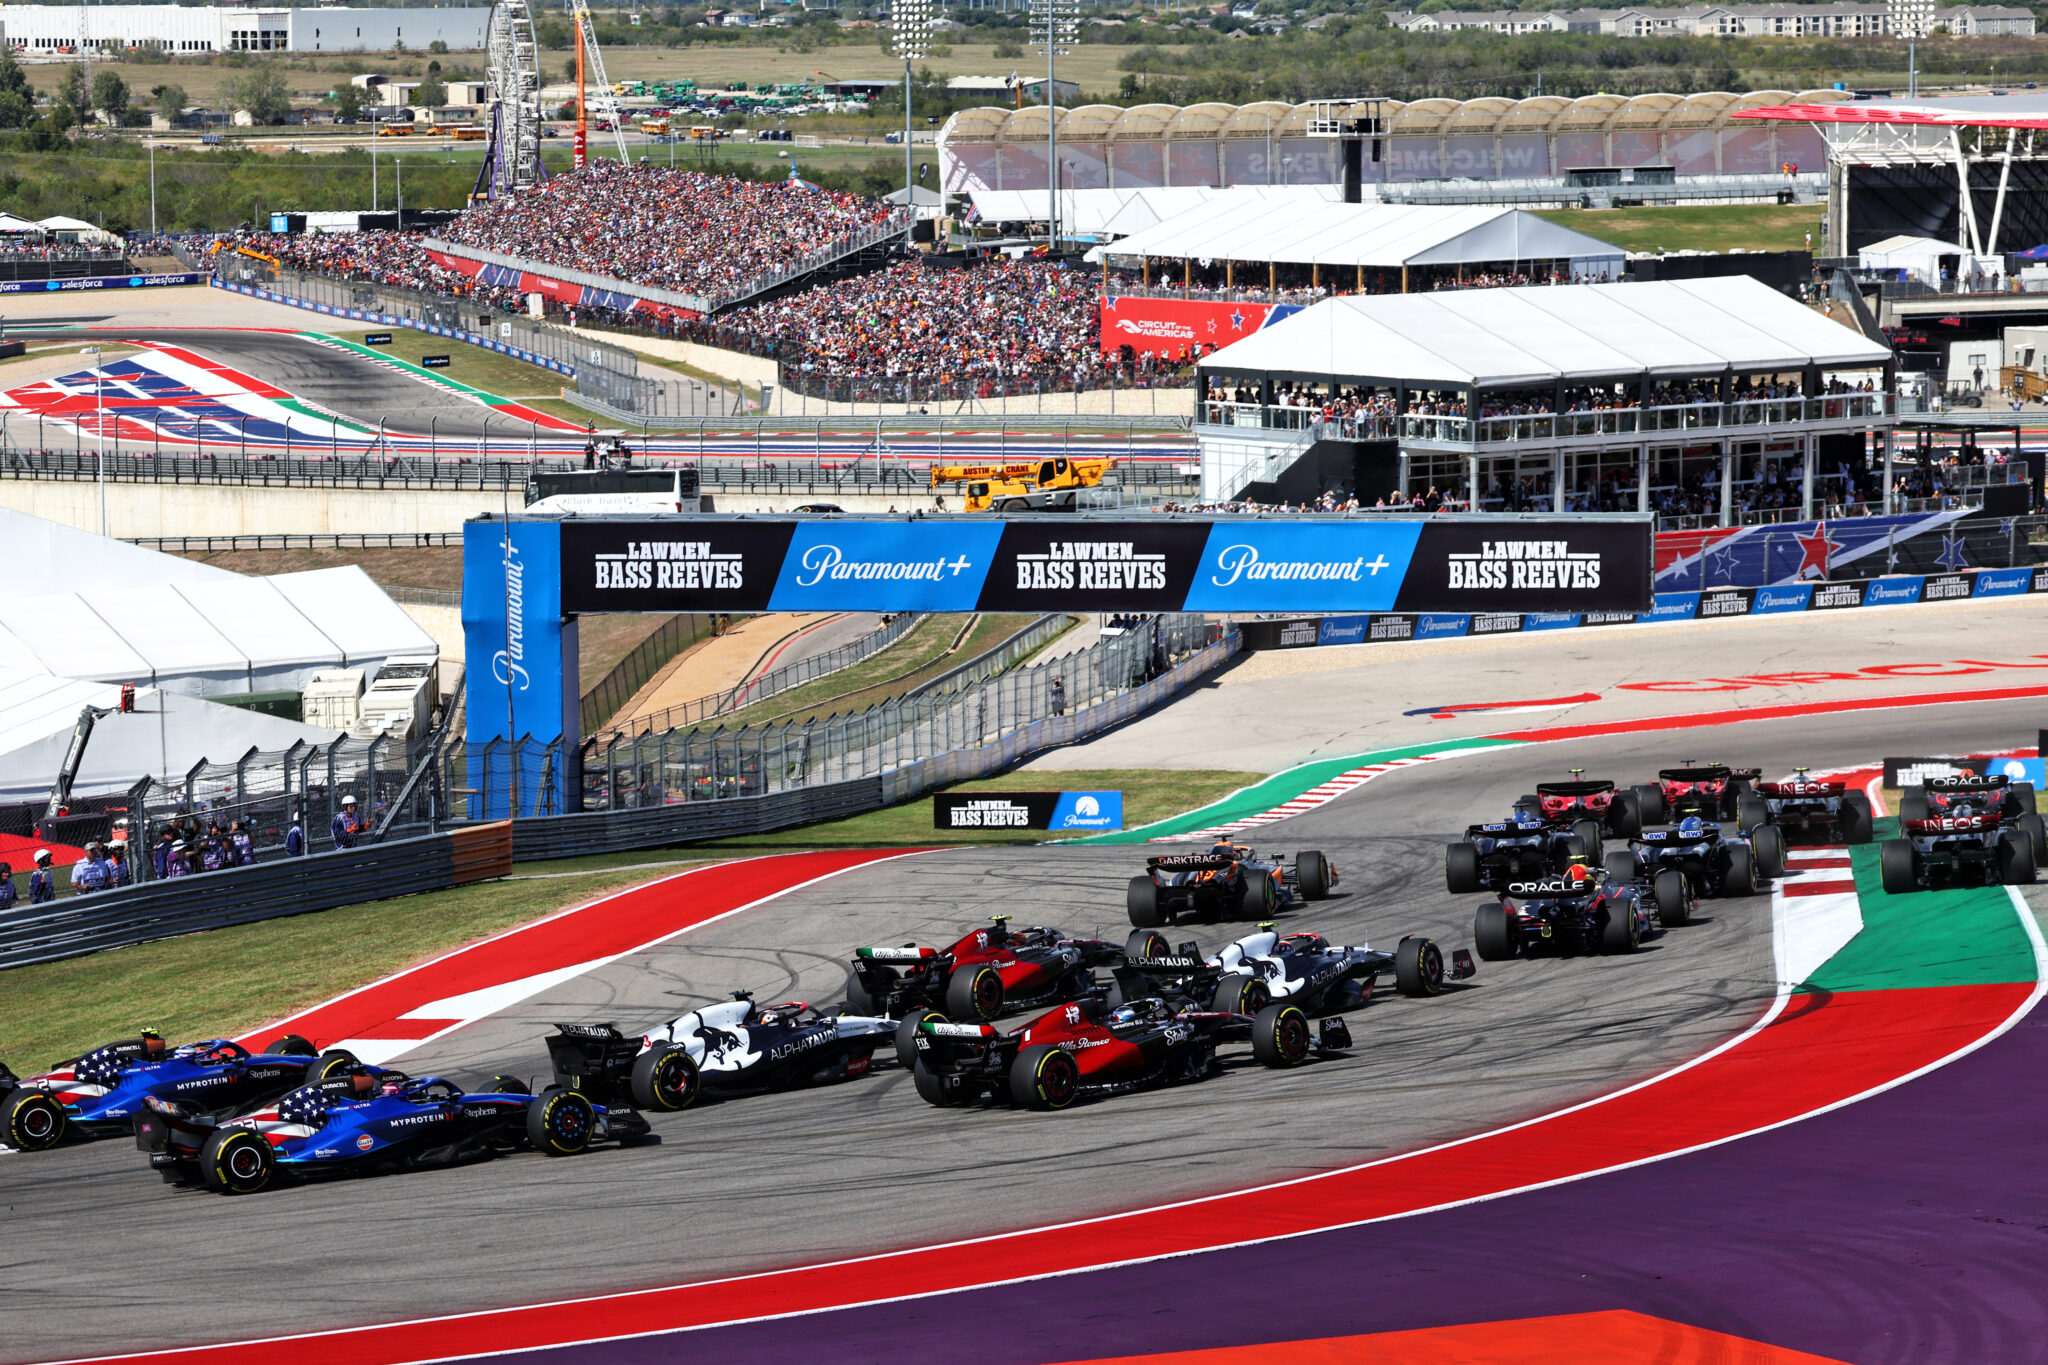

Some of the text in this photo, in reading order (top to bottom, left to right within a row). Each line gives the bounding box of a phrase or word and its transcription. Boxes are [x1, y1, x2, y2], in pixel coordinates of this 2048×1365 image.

[61, 279, 103, 290] salesforce
[144, 275, 185, 287] salesforce
[1138, 320, 1176, 330] CIRCUIT
[1151, 328, 1204, 339] AMERICAS
[963, 464, 1030, 476] AUSTIN CRANE
[628, 542, 711, 560] LAWMEN
[1050, 542, 1134, 560] LAWMEN
[1482, 541, 1568, 560] LAWMEN
[795, 544, 972, 587] Paramount+
[1211, 544, 1390, 587] Paramount+
[595, 561, 743, 589] BASS REEVES
[1016, 561, 1166, 590] BASS REEVES
[1448, 560, 1600, 589] BASS REEVES
[1926, 583, 1970, 599] BASS REEVES
[1979, 575, 2026, 593] Paramount+
[1815, 591, 1860, 607] BASS REEVES
[1869, 584, 1918, 602] Paramount+
[1702, 600, 1748, 616] BASS REEVES
[1757, 592, 1806, 610] Paramount+
[1321, 622, 1363, 640] Paramount+
[1370, 624, 1411, 639] BASS REEVES
[1420, 616, 1466, 634] Paramount+
[1474, 617, 1520, 632] BASS REEVES
[1280, 629, 1316, 645] BASS REEVES
[1778, 782, 1830, 795] INEOS
[1932, 775, 1999, 787] ORACLE
[967, 799, 1012, 810] LAWMEN
[951, 810, 1029, 826] BASS REEVES
[1063, 815, 1111, 827] Paramount+
[1923, 816, 1983, 832] INEOS
[1649, 832, 1667, 840] BWT
[1686, 830, 1703, 838] BWT
[1158, 854, 1222, 866] DARKTRACE
[1508, 880, 1585, 893] ORACLE
[992, 959, 1016, 969] Romeo
[1325, 1019, 1343, 1031] Stake
[771, 1028, 838, 1061] ALPHATAURI
[915, 1037, 930, 1048] FIX
[1078, 1036, 1110, 1049] Romeo
[1163, 1029, 1188, 1046] Stake
[116, 1044, 141, 1052] DURACELL
[249, 1068, 281, 1080] Stephens
[381, 1073, 403, 1082] Acronis
[176, 1076, 228, 1091] MYPROTEIN
[321, 1081, 348, 1090] DURACELL
[463, 1106, 497, 1119] Stephens
[545, 1096, 559, 1120] ZERO
[608, 1107, 631, 1115] Acronis
[390, 1113, 444, 1128] MYPROTEIN
